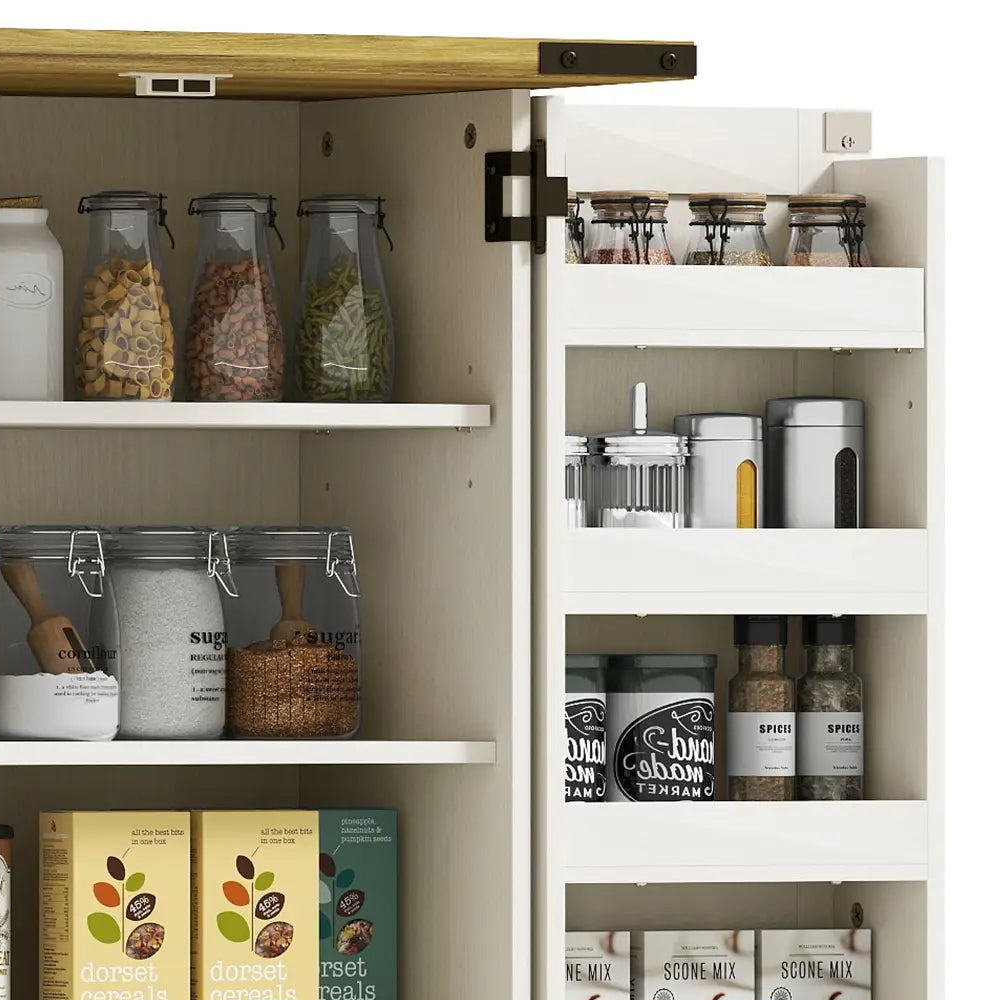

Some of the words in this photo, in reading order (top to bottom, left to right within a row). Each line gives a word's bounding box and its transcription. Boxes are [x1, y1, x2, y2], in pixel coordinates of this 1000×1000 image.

[760, 725, 791, 733] SPICES
[828, 724, 859, 733] SPICES
[81, 962, 158, 982] dorset
[211, 961, 287, 981] dorset
[589, 964, 612, 981] MIX
[664, 962, 706, 980] SCONE
[713, 962, 736, 979] MIX
[781, 961, 823, 979] SCONE
[829, 961, 853, 978] MIX
